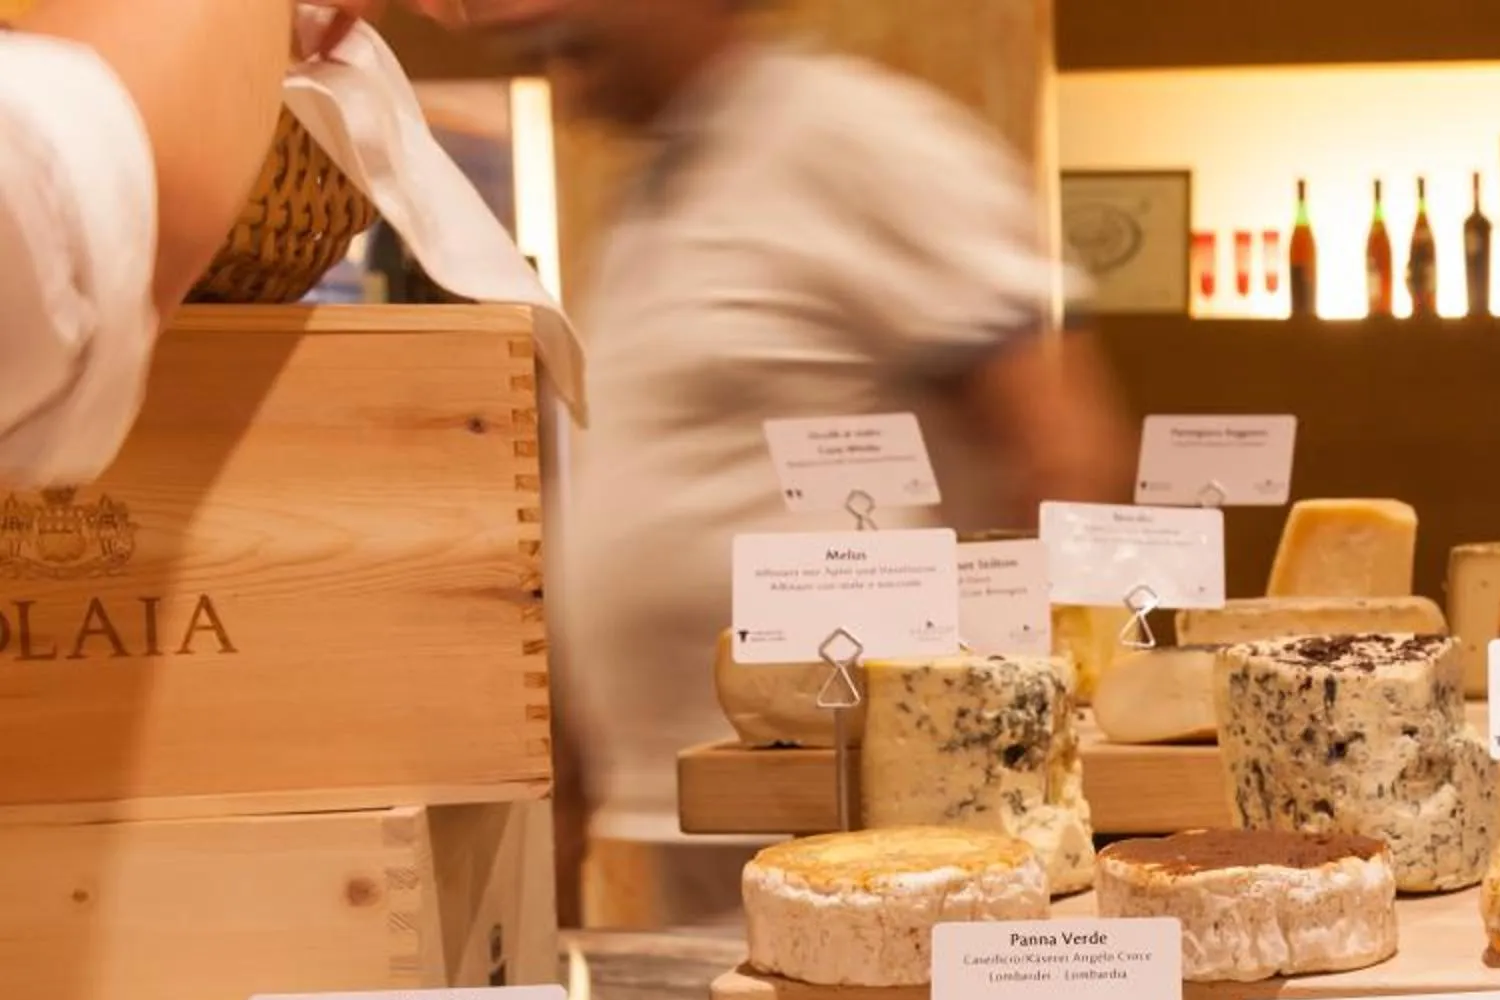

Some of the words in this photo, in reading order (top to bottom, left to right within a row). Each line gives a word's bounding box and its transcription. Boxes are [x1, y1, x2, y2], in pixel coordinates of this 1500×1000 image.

[0, 593, 239, 661] LAIA
[1010, 933, 1057, 945] Panna
[1061, 932, 1108, 945] Verde
